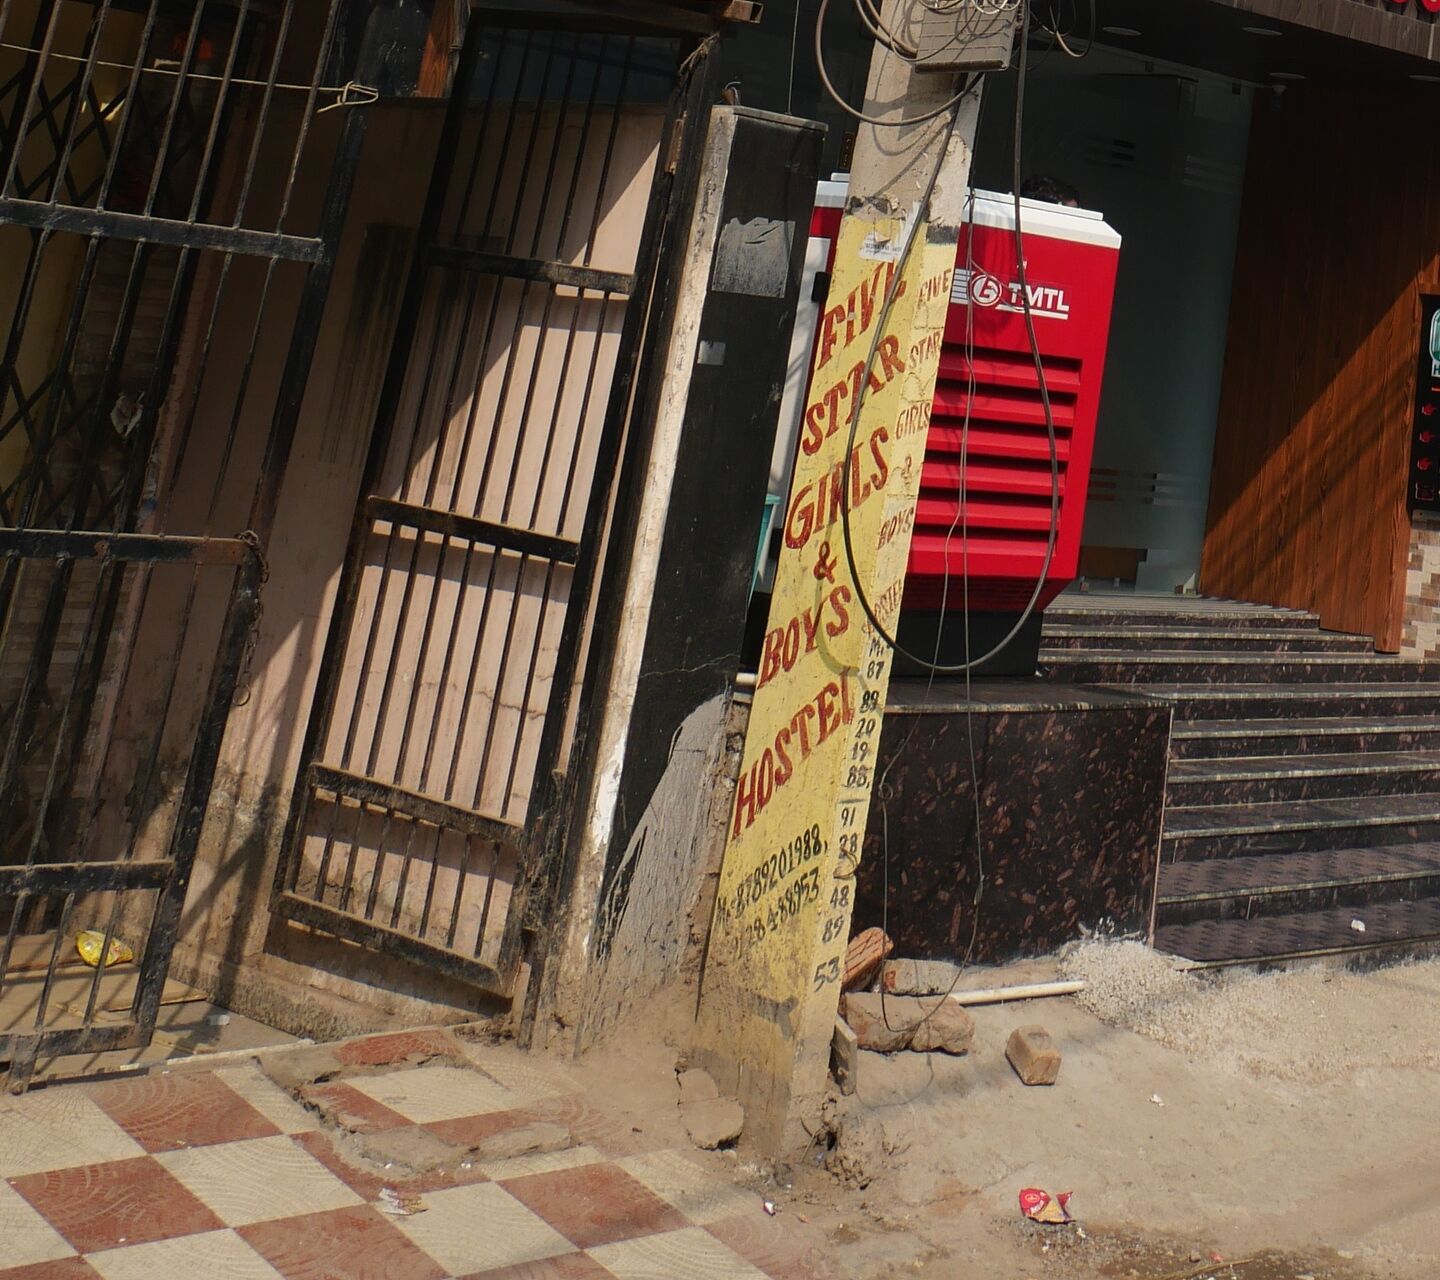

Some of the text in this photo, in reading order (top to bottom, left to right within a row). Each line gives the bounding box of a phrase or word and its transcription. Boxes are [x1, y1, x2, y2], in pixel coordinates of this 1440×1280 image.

[918, 268, 952, 306] FIVE
[802, 334, 907, 457] STAR
[896, 401, 931, 441] GIRLS
[784, 425, 890, 551] GIRLS
[813, 541, 840, 586] &
[757, 584, 854, 692] BOYS
[867, 660, 885, 680] 87
[854, 718, 876, 739] 20
[731, 666, 856, 840] HOSTEL
[851, 741, 870, 762] 19
[841, 806, 857, 827] 91
[829, 885, 851, 910] 48
